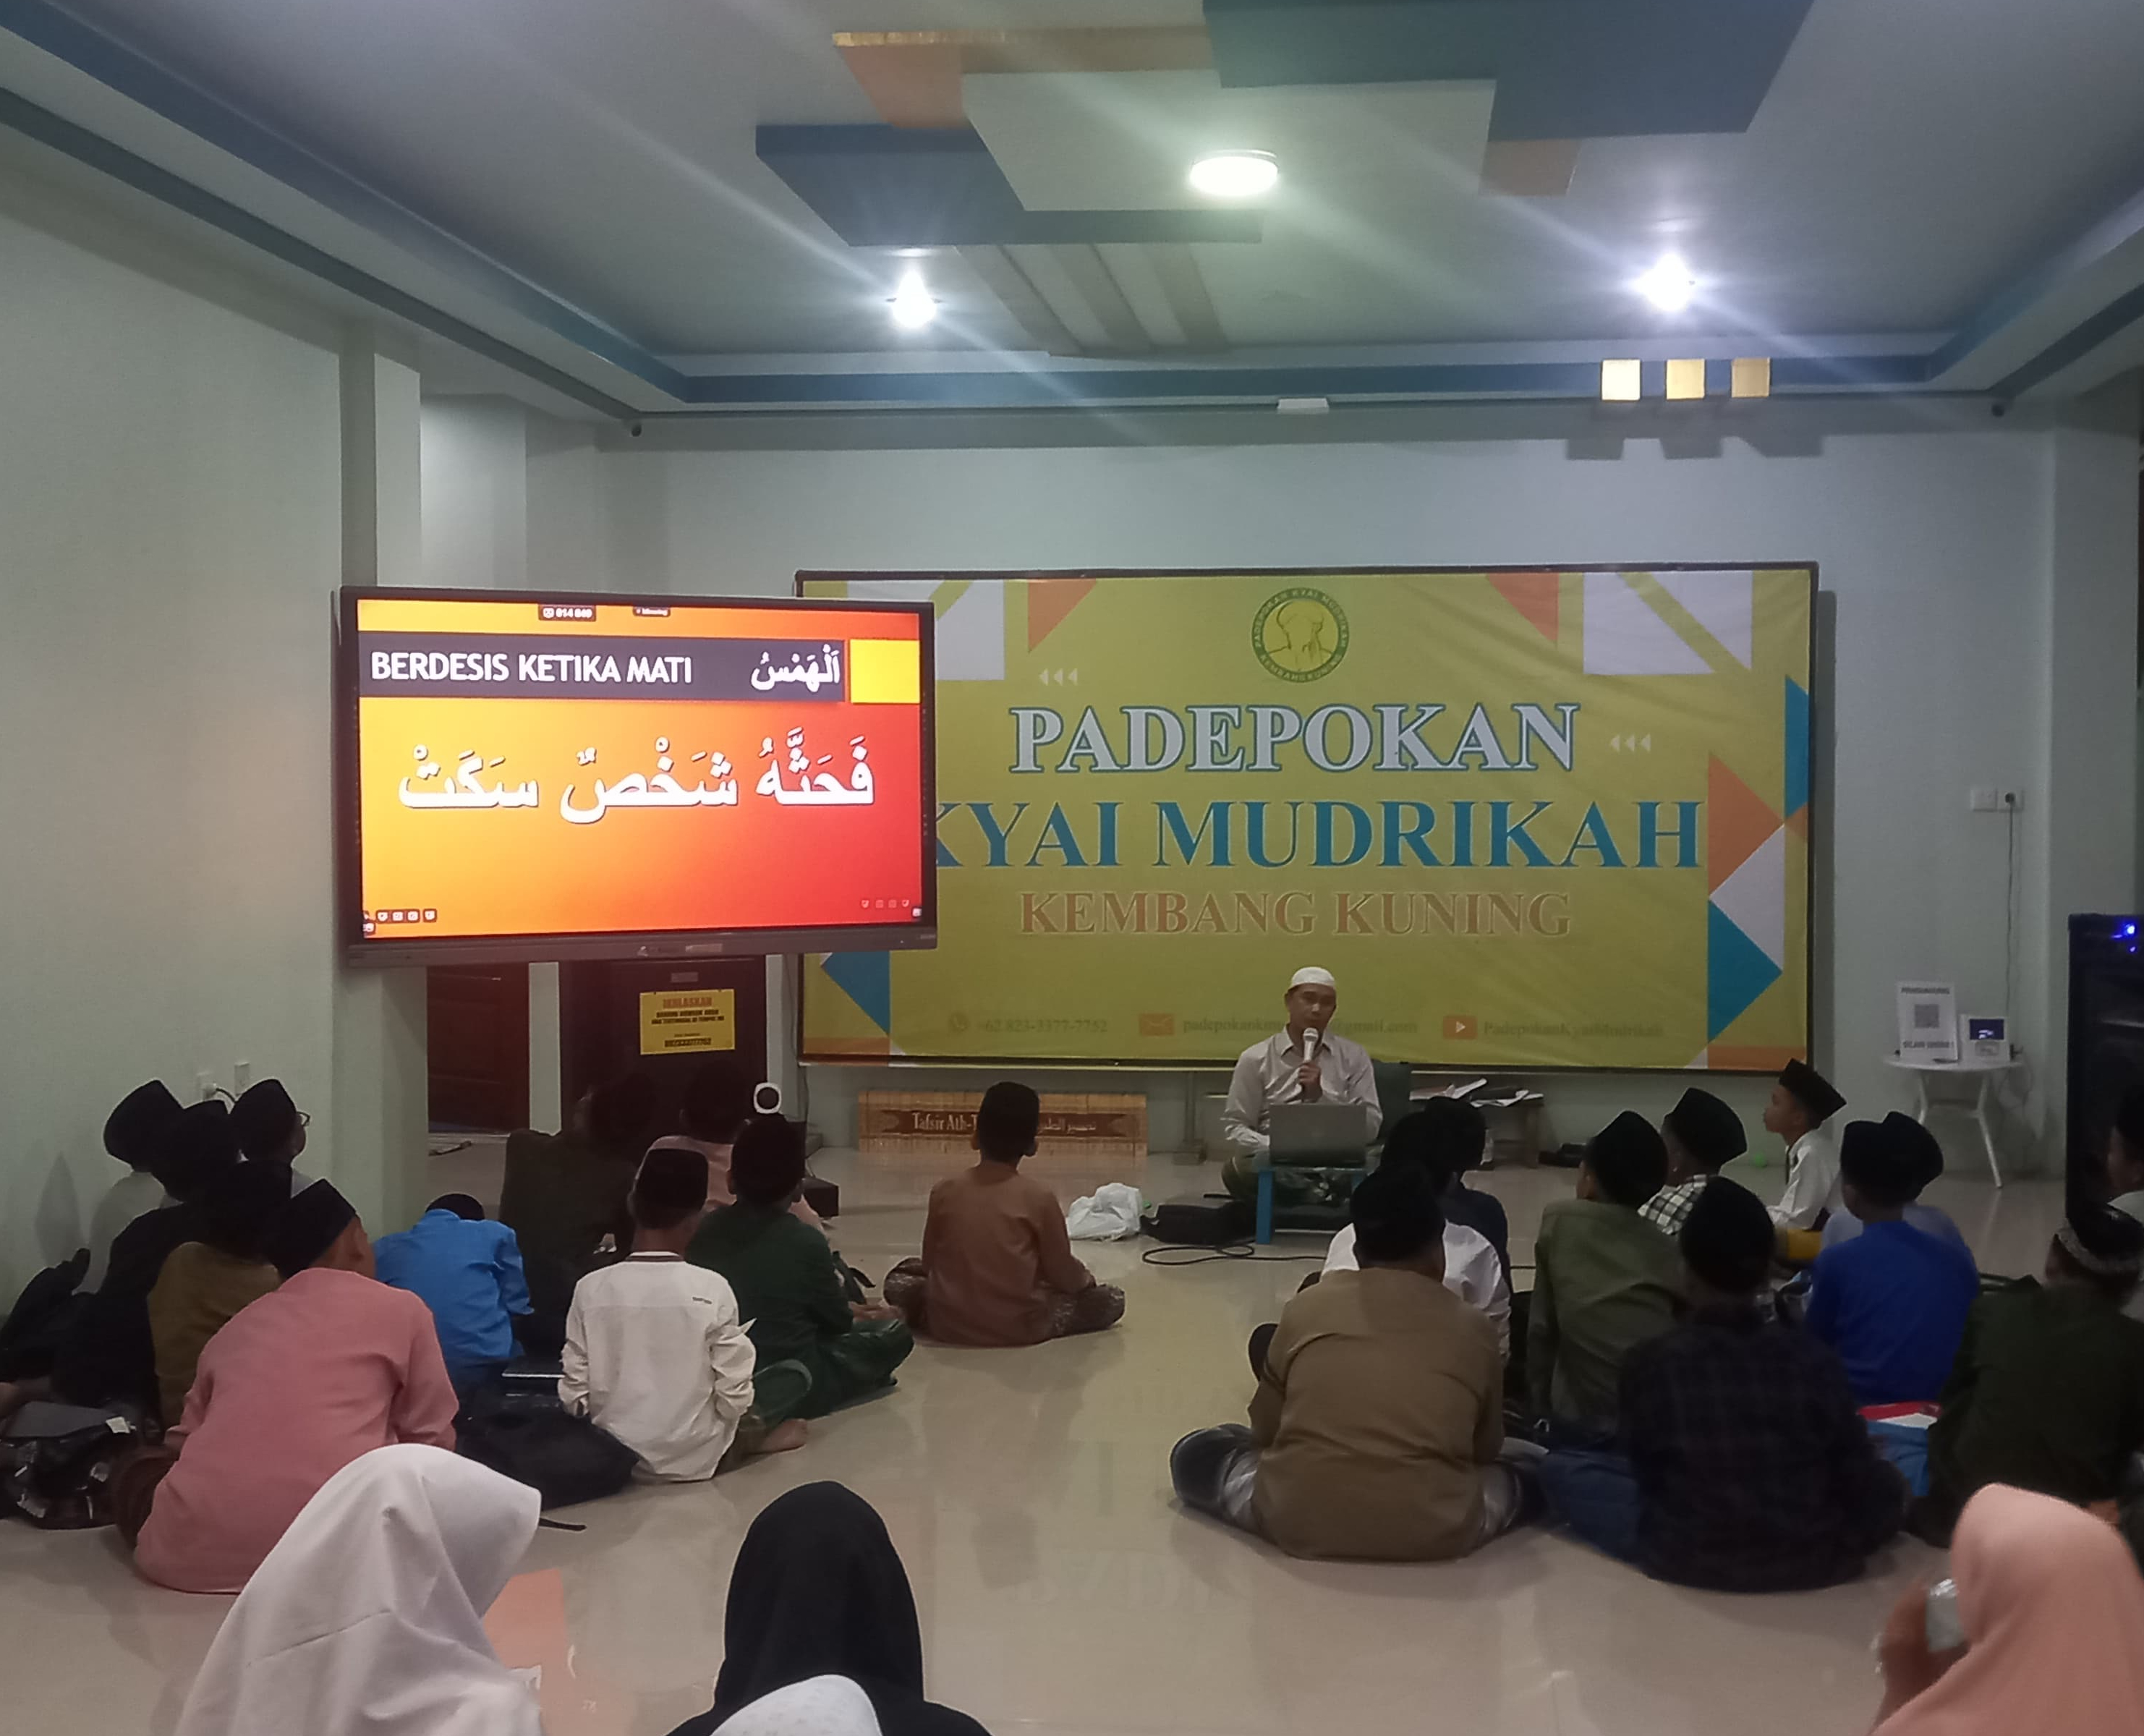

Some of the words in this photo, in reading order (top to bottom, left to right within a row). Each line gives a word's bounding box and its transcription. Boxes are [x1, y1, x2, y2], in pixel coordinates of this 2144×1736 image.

[370, 652, 509, 682] BERDESIS
[518, 655, 621, 684] KETIKA
[626, 656, 692, 684] MATI
[1009, 702, 1581, 773] PADEPOKAN
[1152, 800, 1705, 868] MUDRIKAH
[1019, 891, 1315, 935] KEMBANG
[1336, 890, 1570, 936] KUNING
[912, 1112, 945, 1131] Tafsir
